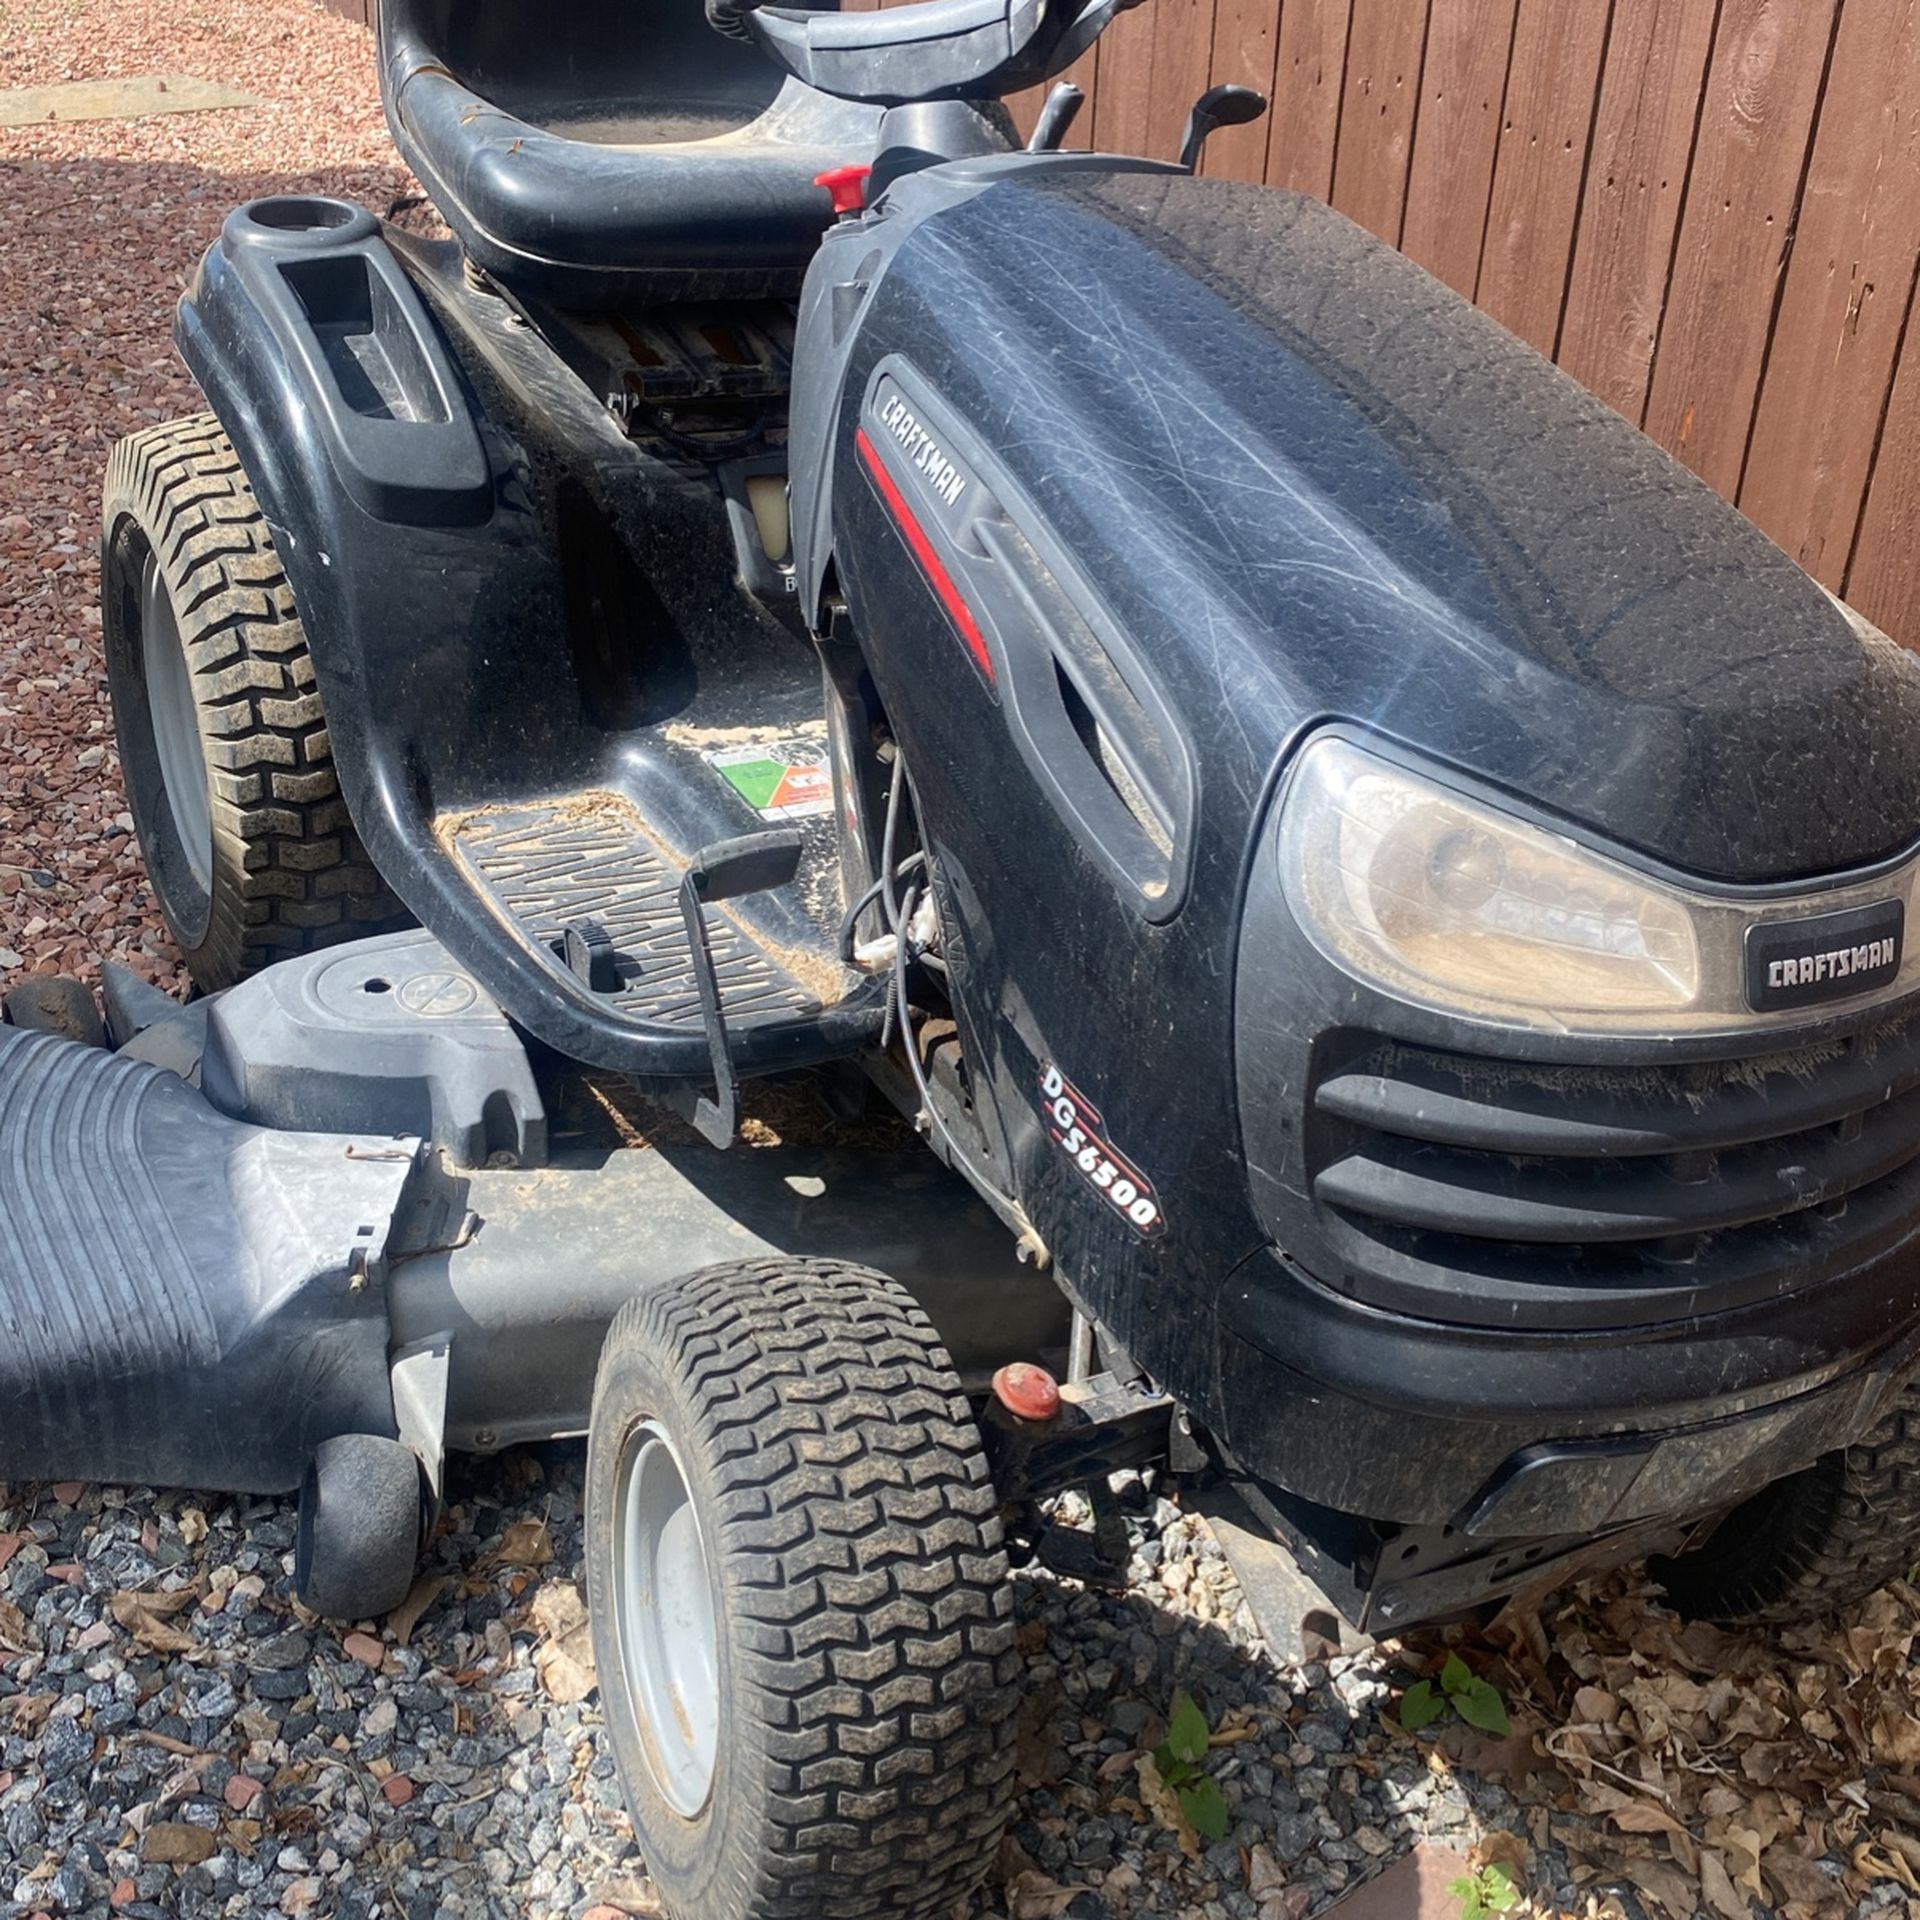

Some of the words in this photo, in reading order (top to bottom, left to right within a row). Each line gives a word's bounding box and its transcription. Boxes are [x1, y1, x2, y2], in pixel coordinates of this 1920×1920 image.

[881, 395, 966, 507] CRAFTSMAN
[1768, 937, 1895, 988] CRAFTSMAN
[1043, 1066, 1157, 1225] DGS6500
